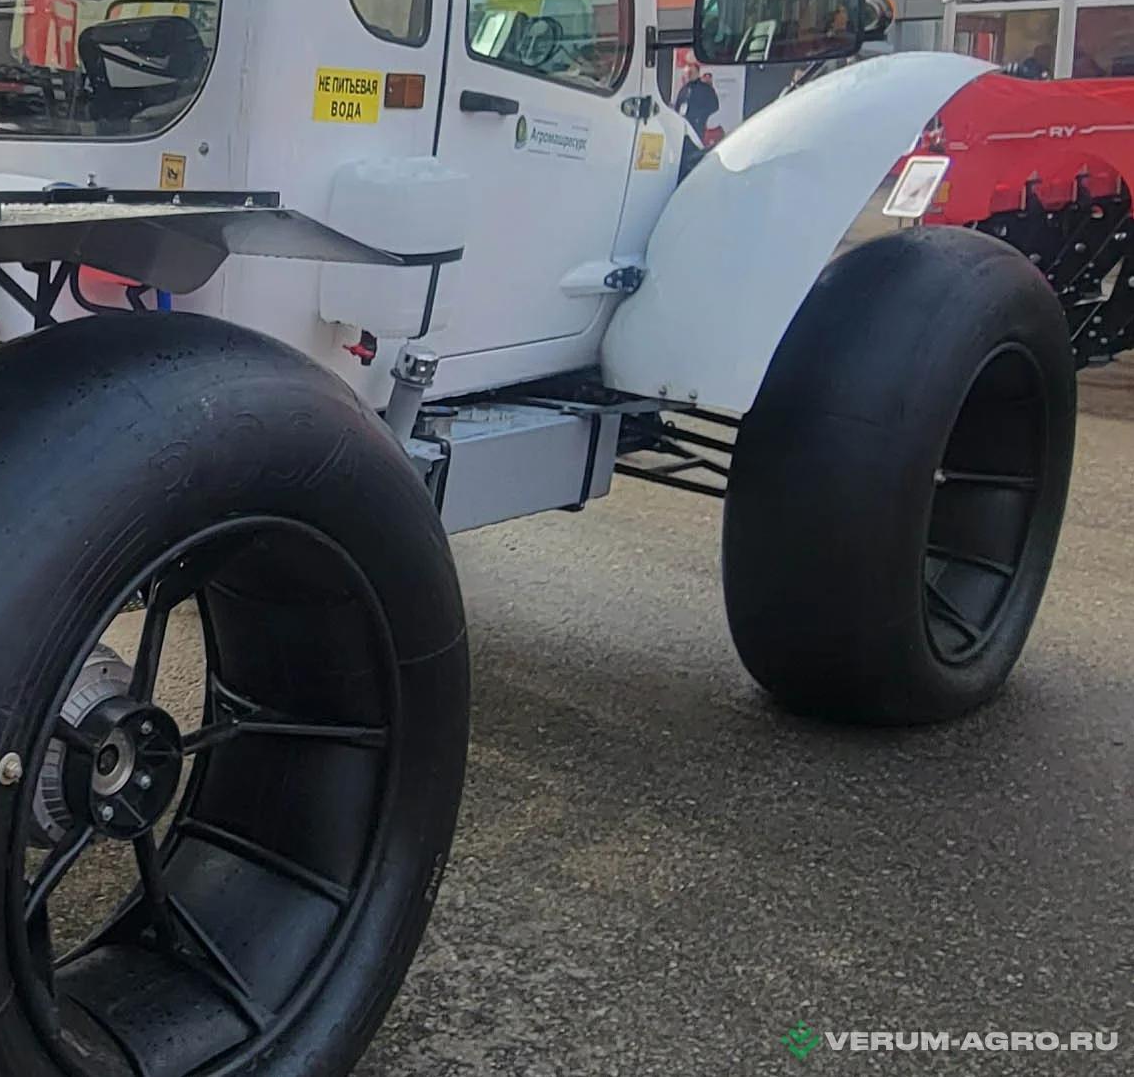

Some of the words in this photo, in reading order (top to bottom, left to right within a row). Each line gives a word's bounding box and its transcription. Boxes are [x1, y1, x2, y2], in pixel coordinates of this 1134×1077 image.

[318, 75, 331, 92] НЕ
[332, 76, 379, 95] ПИТЬЕВАЯ
[330, 101, 362, 120] ВОДА
